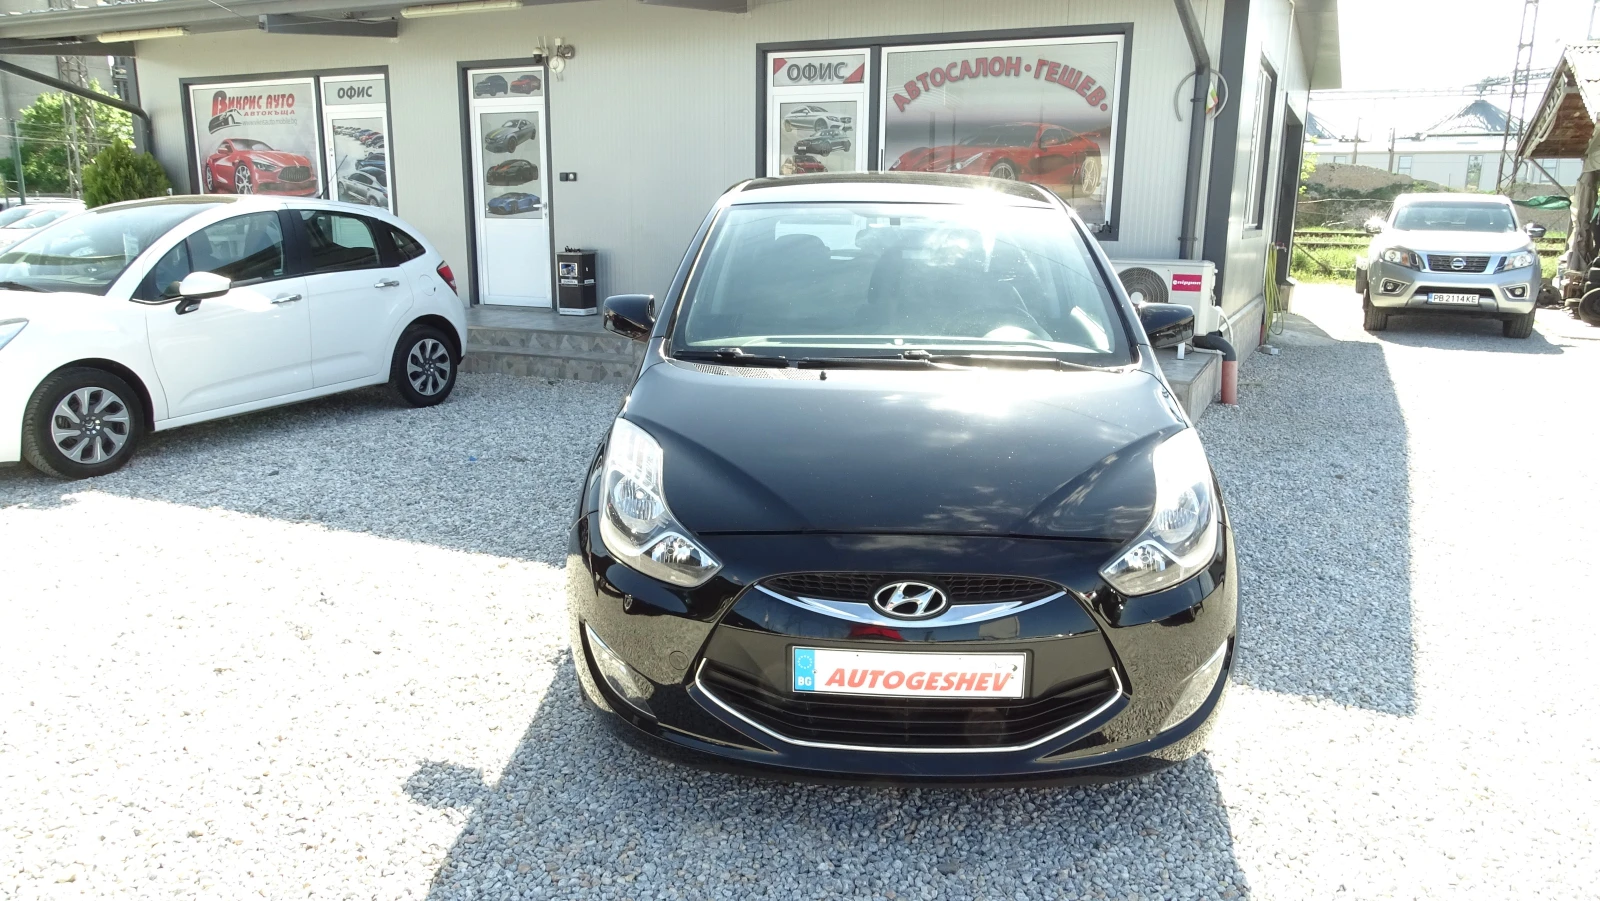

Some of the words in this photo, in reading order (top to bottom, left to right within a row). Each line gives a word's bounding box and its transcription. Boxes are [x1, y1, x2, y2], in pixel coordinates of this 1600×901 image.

[787, 62, 848, 82] ОФИС
[337, 85, 373, 100] ОФИС
[892, 56, 1022, 112] АВТОСАЛОН
[1033, 58, 1108, 107] ГЕШЕВ
[243, 109, 296, 117] АВТОКЪЩА
[797, 676, 812, 687] BG
[825, 668, 1011, 691] AUTOGESHEV
